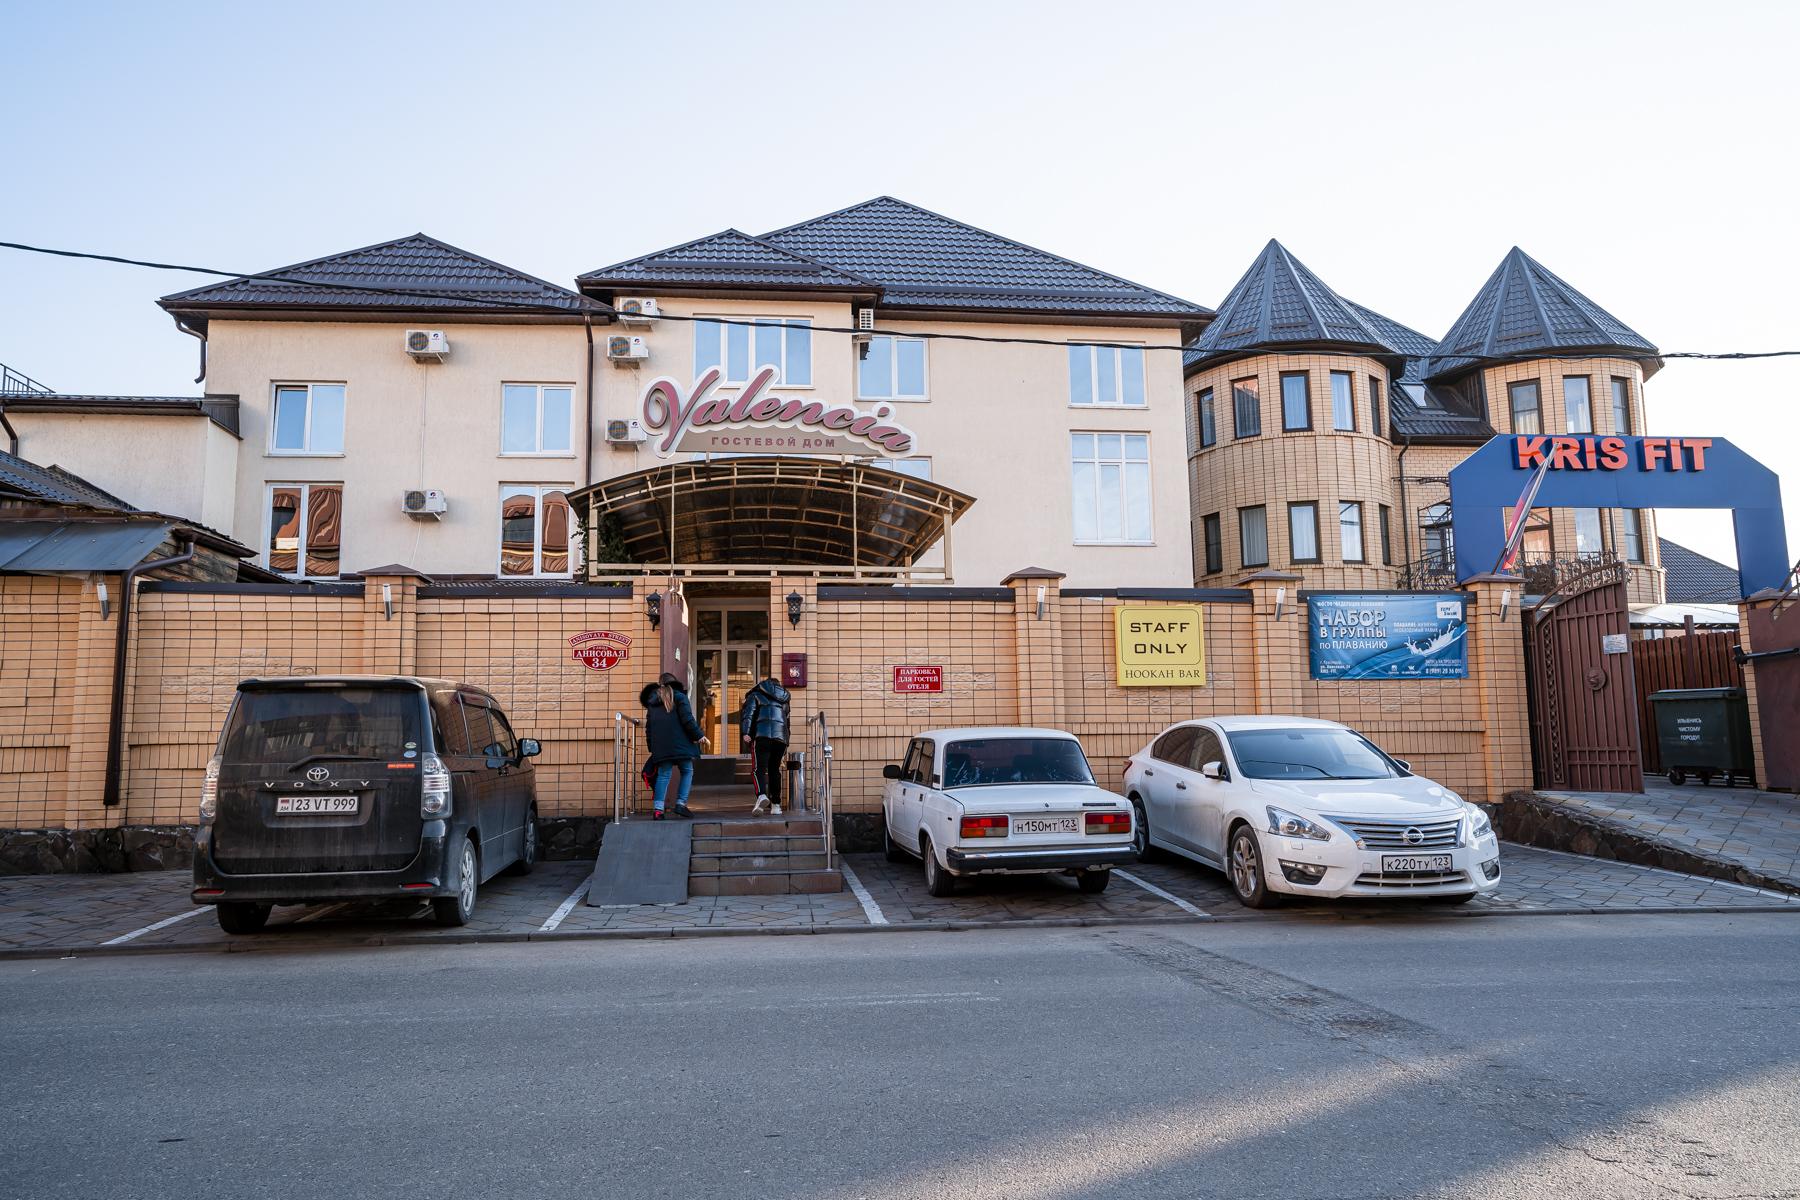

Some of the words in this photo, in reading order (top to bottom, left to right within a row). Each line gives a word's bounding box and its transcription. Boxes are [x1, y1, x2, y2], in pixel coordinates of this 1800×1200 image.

[643, 368, 912, 452] Valencia
[711, 436, 796, 447] ГОСТЕВОЙ
[802, 438, 835, 448] ДОМ
[1516, 436, 1629, 470] KRIS
[1643, 436, 1713, 471] FIT
[1319, 609, 1386, 627] НАБОР
[1130, 622, 1190, 633] STAFF
[1320, 627, 1328, 638] В
[1332, 627, 1387, 638] ГРУППЫ
[608, 633, 629, 644] STREET
[1134, 643, 1188, 654] ONLY
[1332, 640, 1388, 649] ПЛАВАНИЮ
[592, 658, 607, 668] 34
[1125, 669, 1174, 679] HOOKAH
[1179, 669, 1200, 678] BAR
[314, 799, 331, 810] VT
[333, 798, 356, 810] 999
